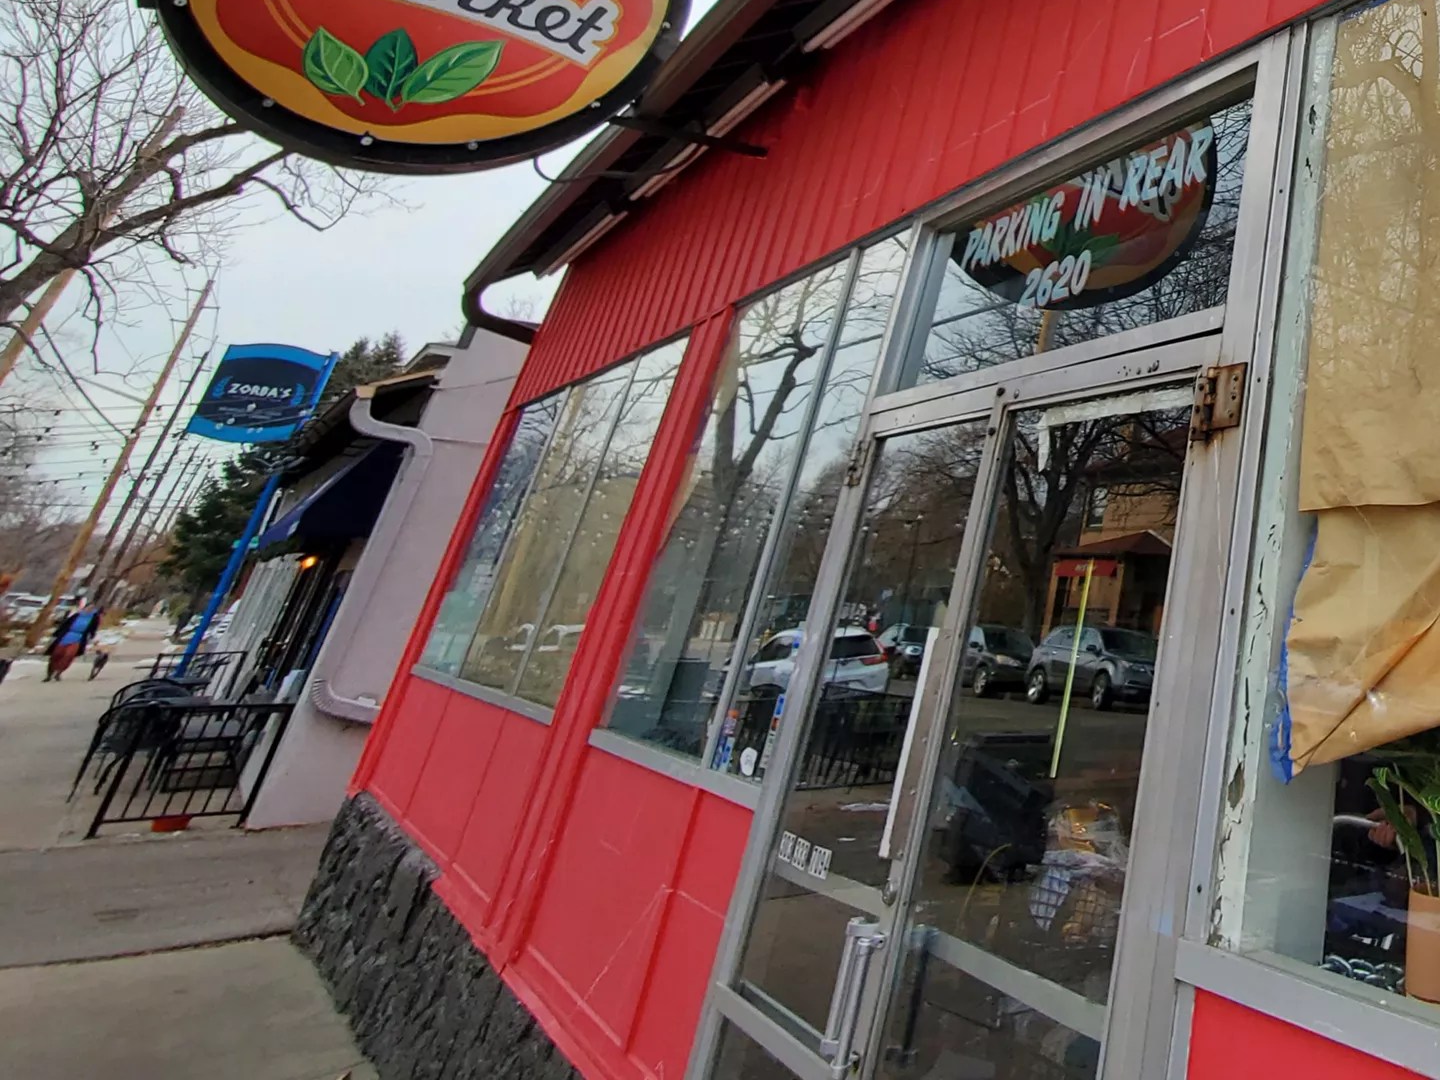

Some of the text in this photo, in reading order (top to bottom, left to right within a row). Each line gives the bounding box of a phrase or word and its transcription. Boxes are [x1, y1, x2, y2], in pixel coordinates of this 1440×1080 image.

[960, 126, 1214, 271] PARKING IN REAR
[1018, 249, 1092, 308] 2620
[227, 382, 292, 399] ZORBA'S
